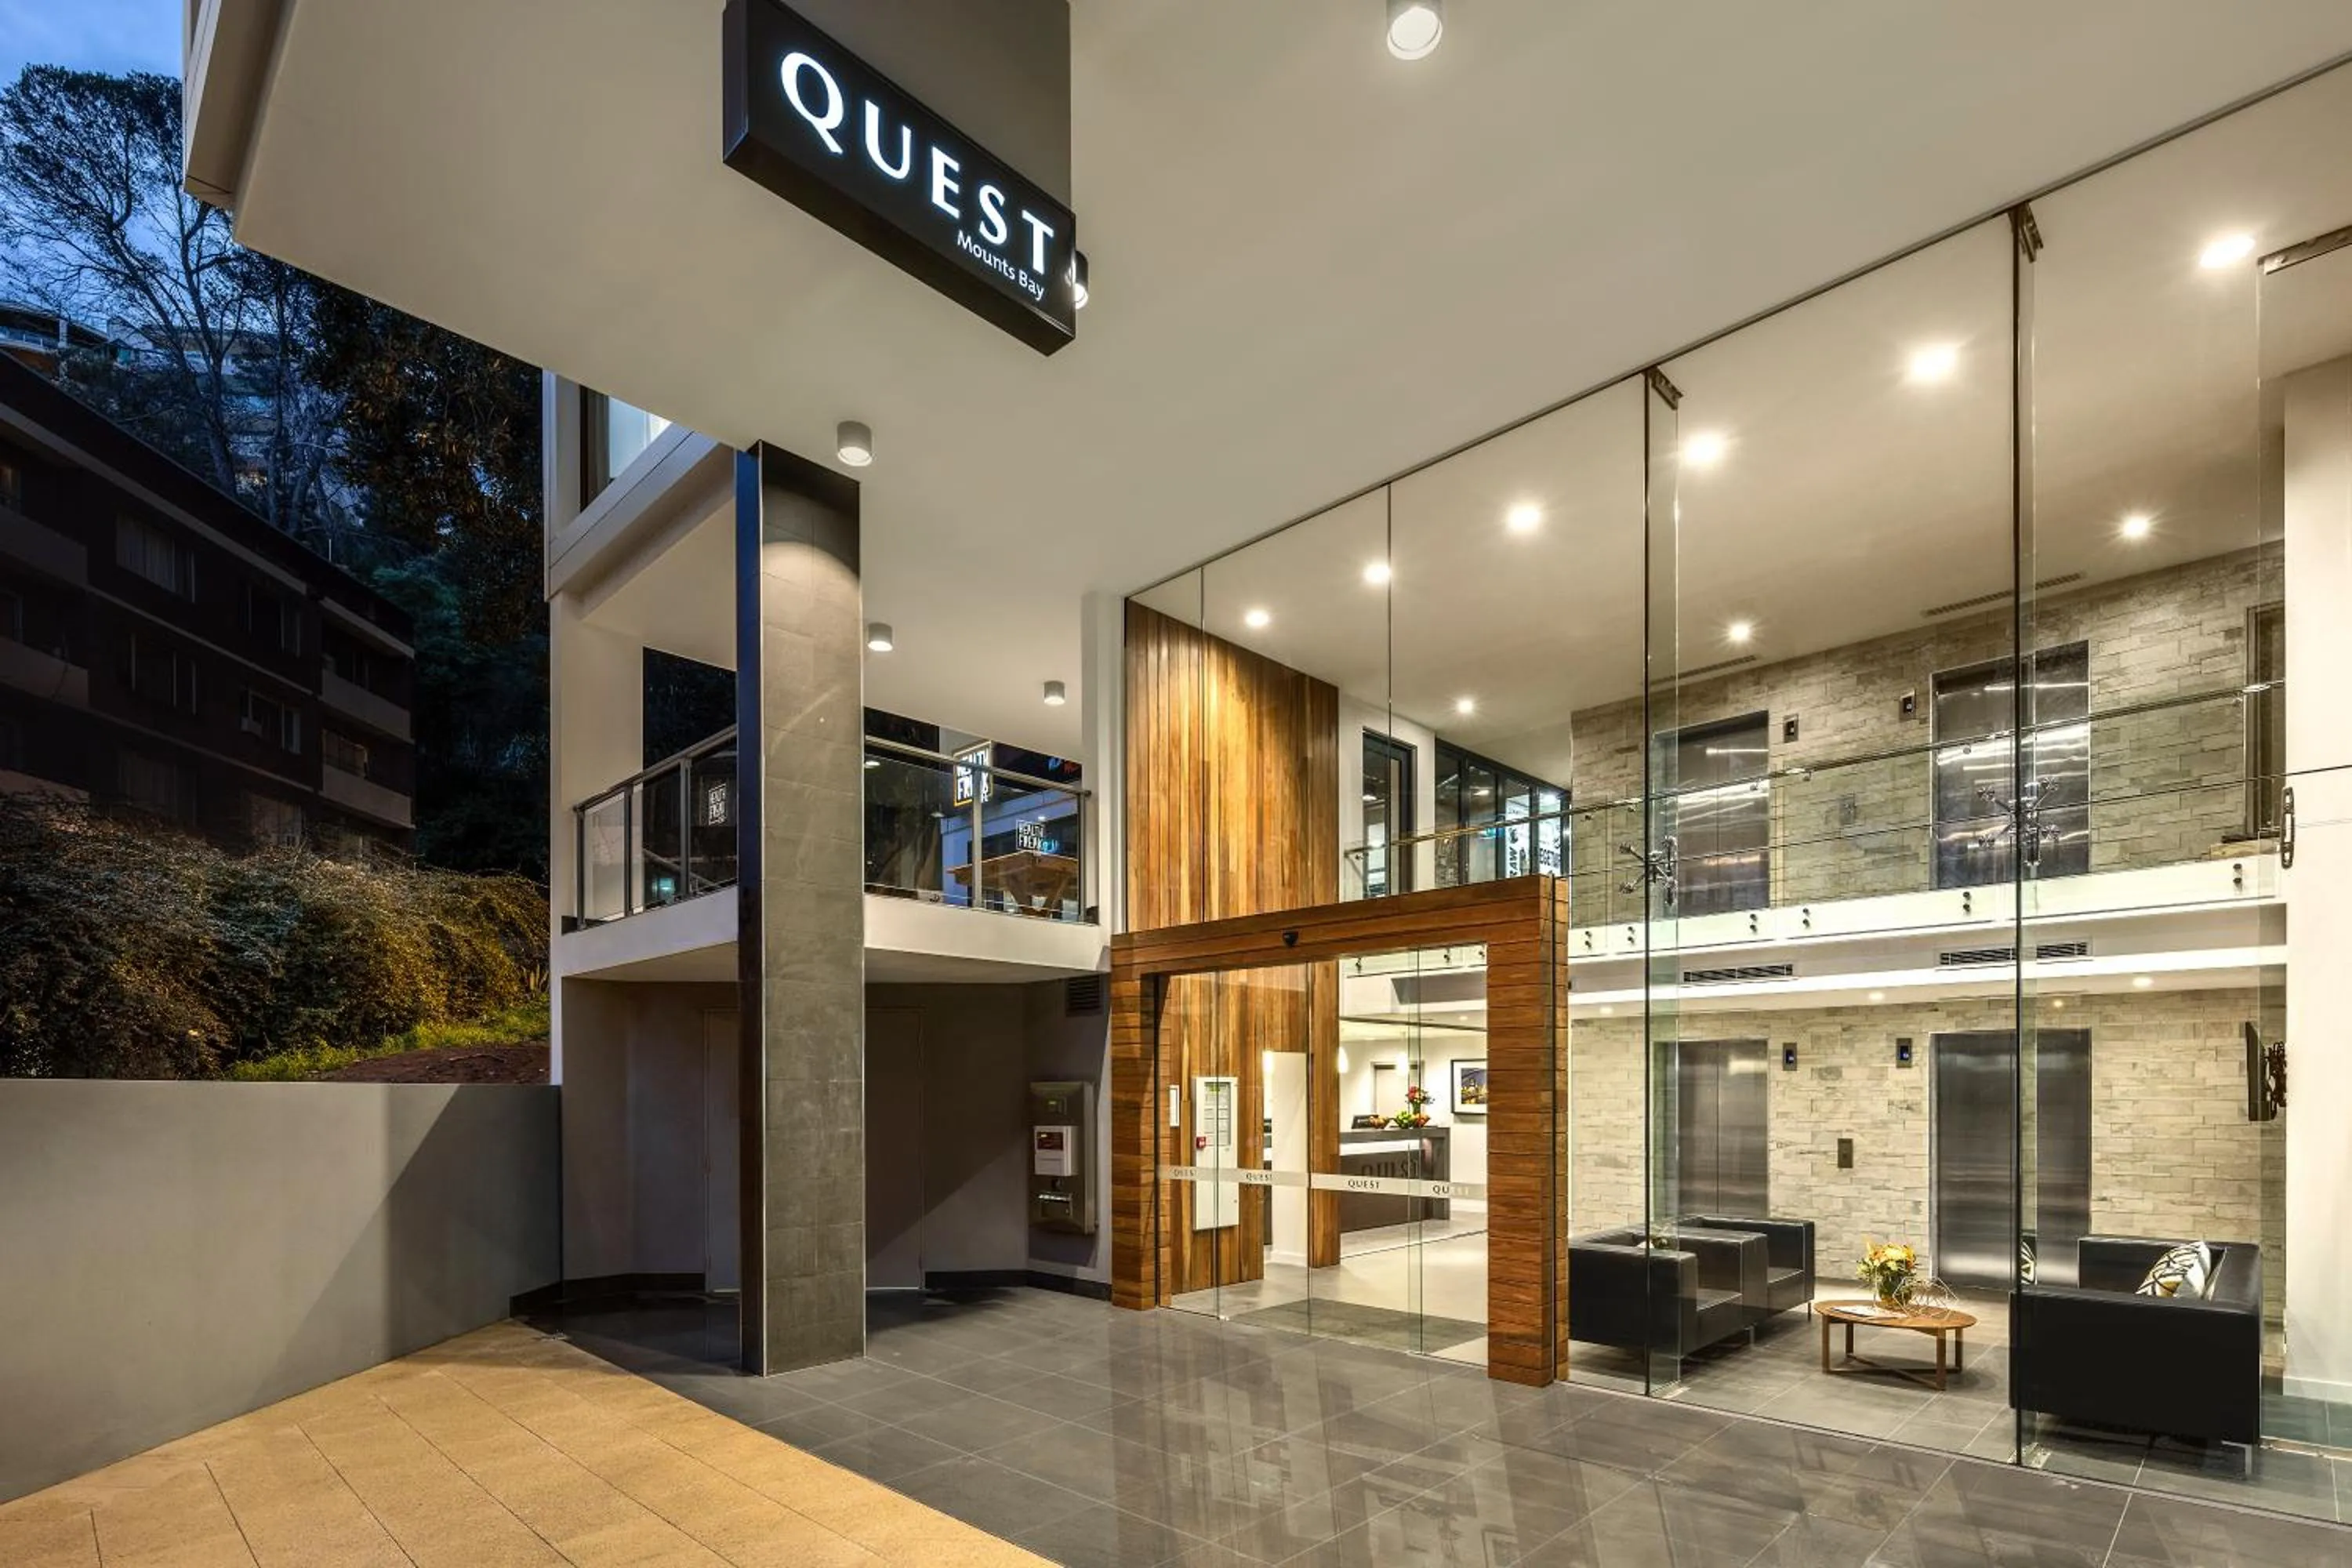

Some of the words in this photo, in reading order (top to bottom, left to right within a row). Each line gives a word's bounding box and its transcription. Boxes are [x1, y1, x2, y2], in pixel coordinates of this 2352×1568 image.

[780, 52, 1054, 275] QUEST
[956, 230, 1015, 280] Mounts
[1018, 269, 1044, 302] Bay
[1348, 1178, 1380, 1190] QUEST
